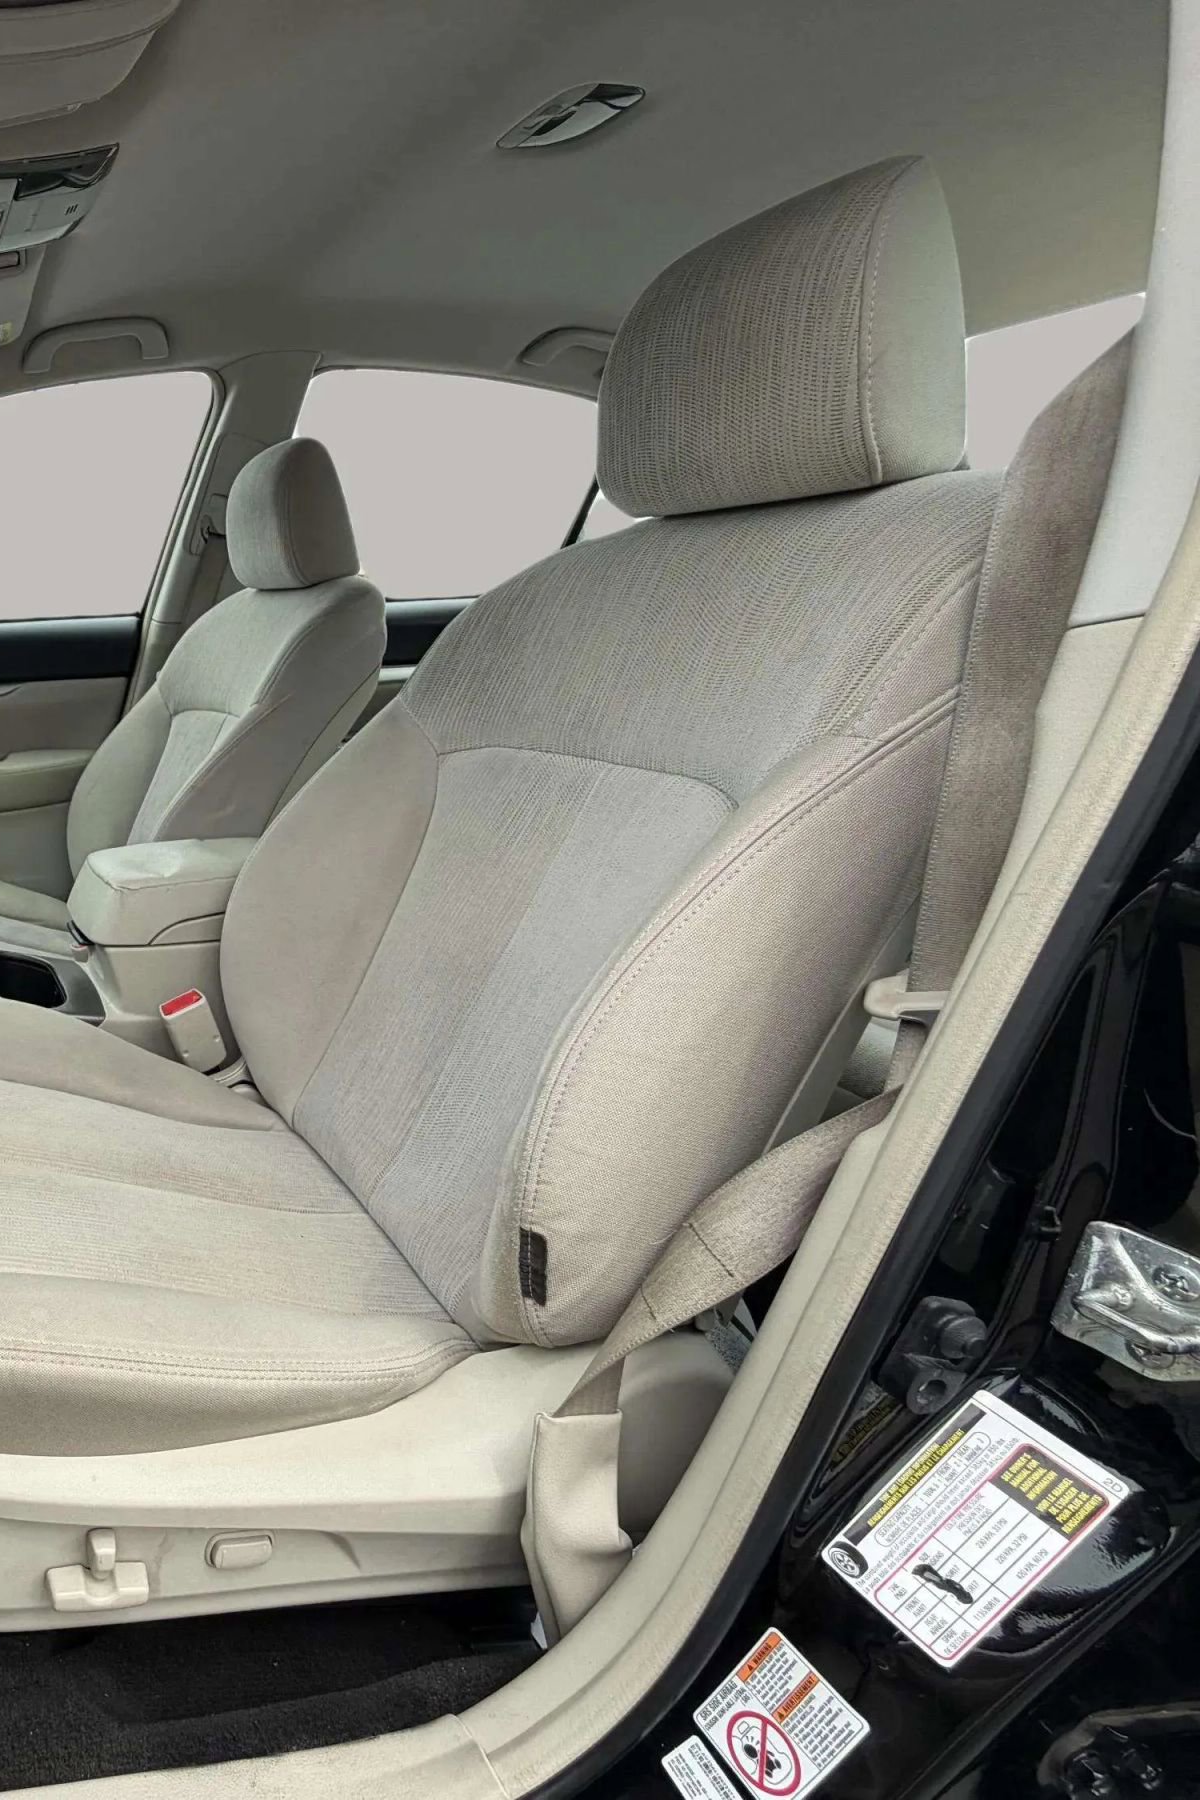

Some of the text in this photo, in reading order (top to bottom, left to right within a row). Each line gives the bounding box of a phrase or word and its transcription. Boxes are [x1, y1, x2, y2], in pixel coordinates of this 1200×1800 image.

[1102, 1477, 1124, 1493] 2D
[752, 1642, 772, 1665] WARNING
[699, 1678, 738, 1721] SRS SIDE AIRBAG
[782, 1676, 815, 1713] AVERTISSEMENT
